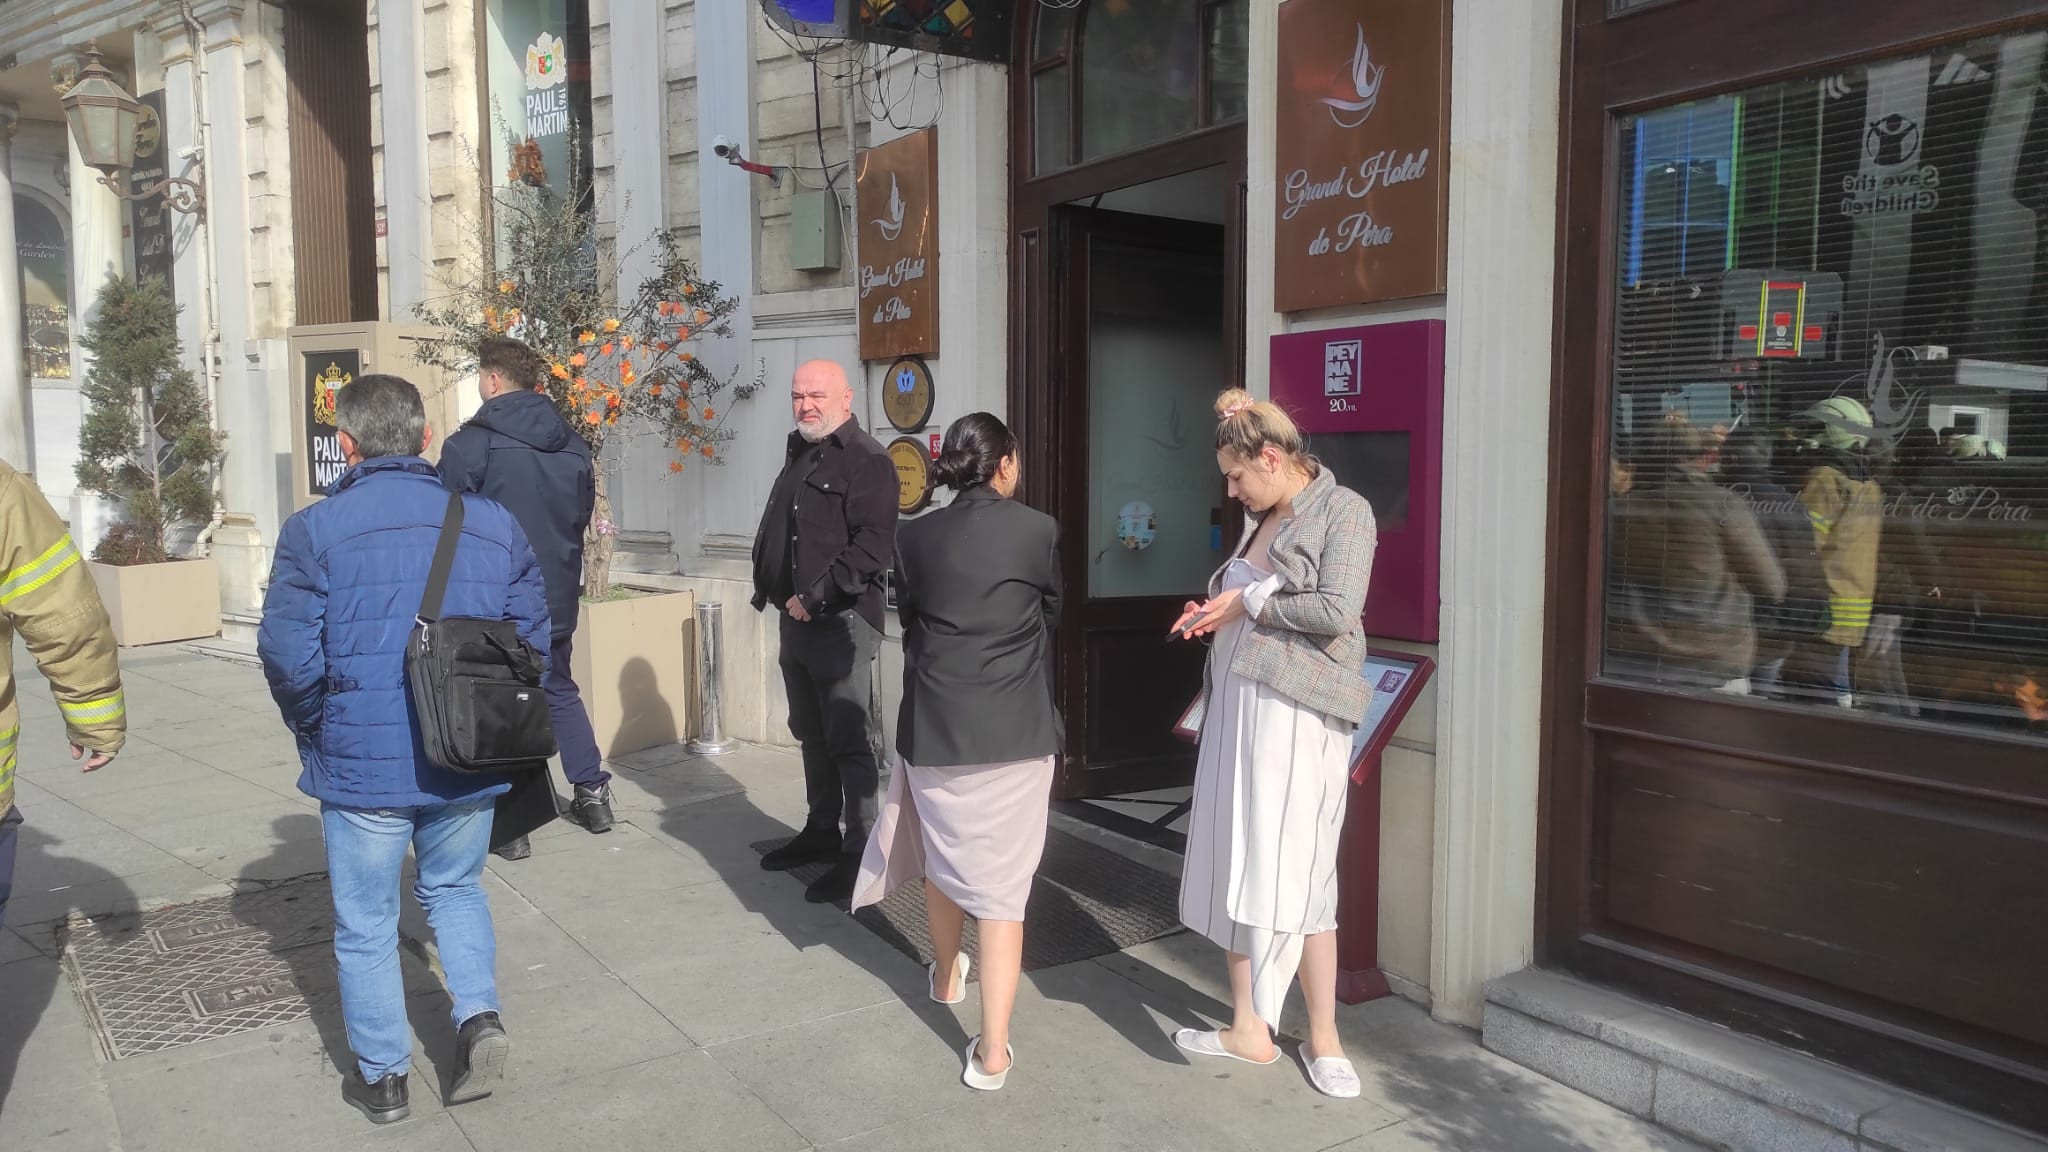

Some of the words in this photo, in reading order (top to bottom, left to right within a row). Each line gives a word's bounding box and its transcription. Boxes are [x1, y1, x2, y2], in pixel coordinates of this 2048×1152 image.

[526, 91, 558, 117] PAUL
[559, 87, 567, 110] 1961
[527, 110, 568, 139] MARTIN
[1282, 166, 1347, 220] Grand
[1346, 148, 1430, 198] Hotel
[1335, 211, 1393, 252] Pera
[1911, 492, 1943, 520] de
[1948, 485, 2033, 521] Pera
